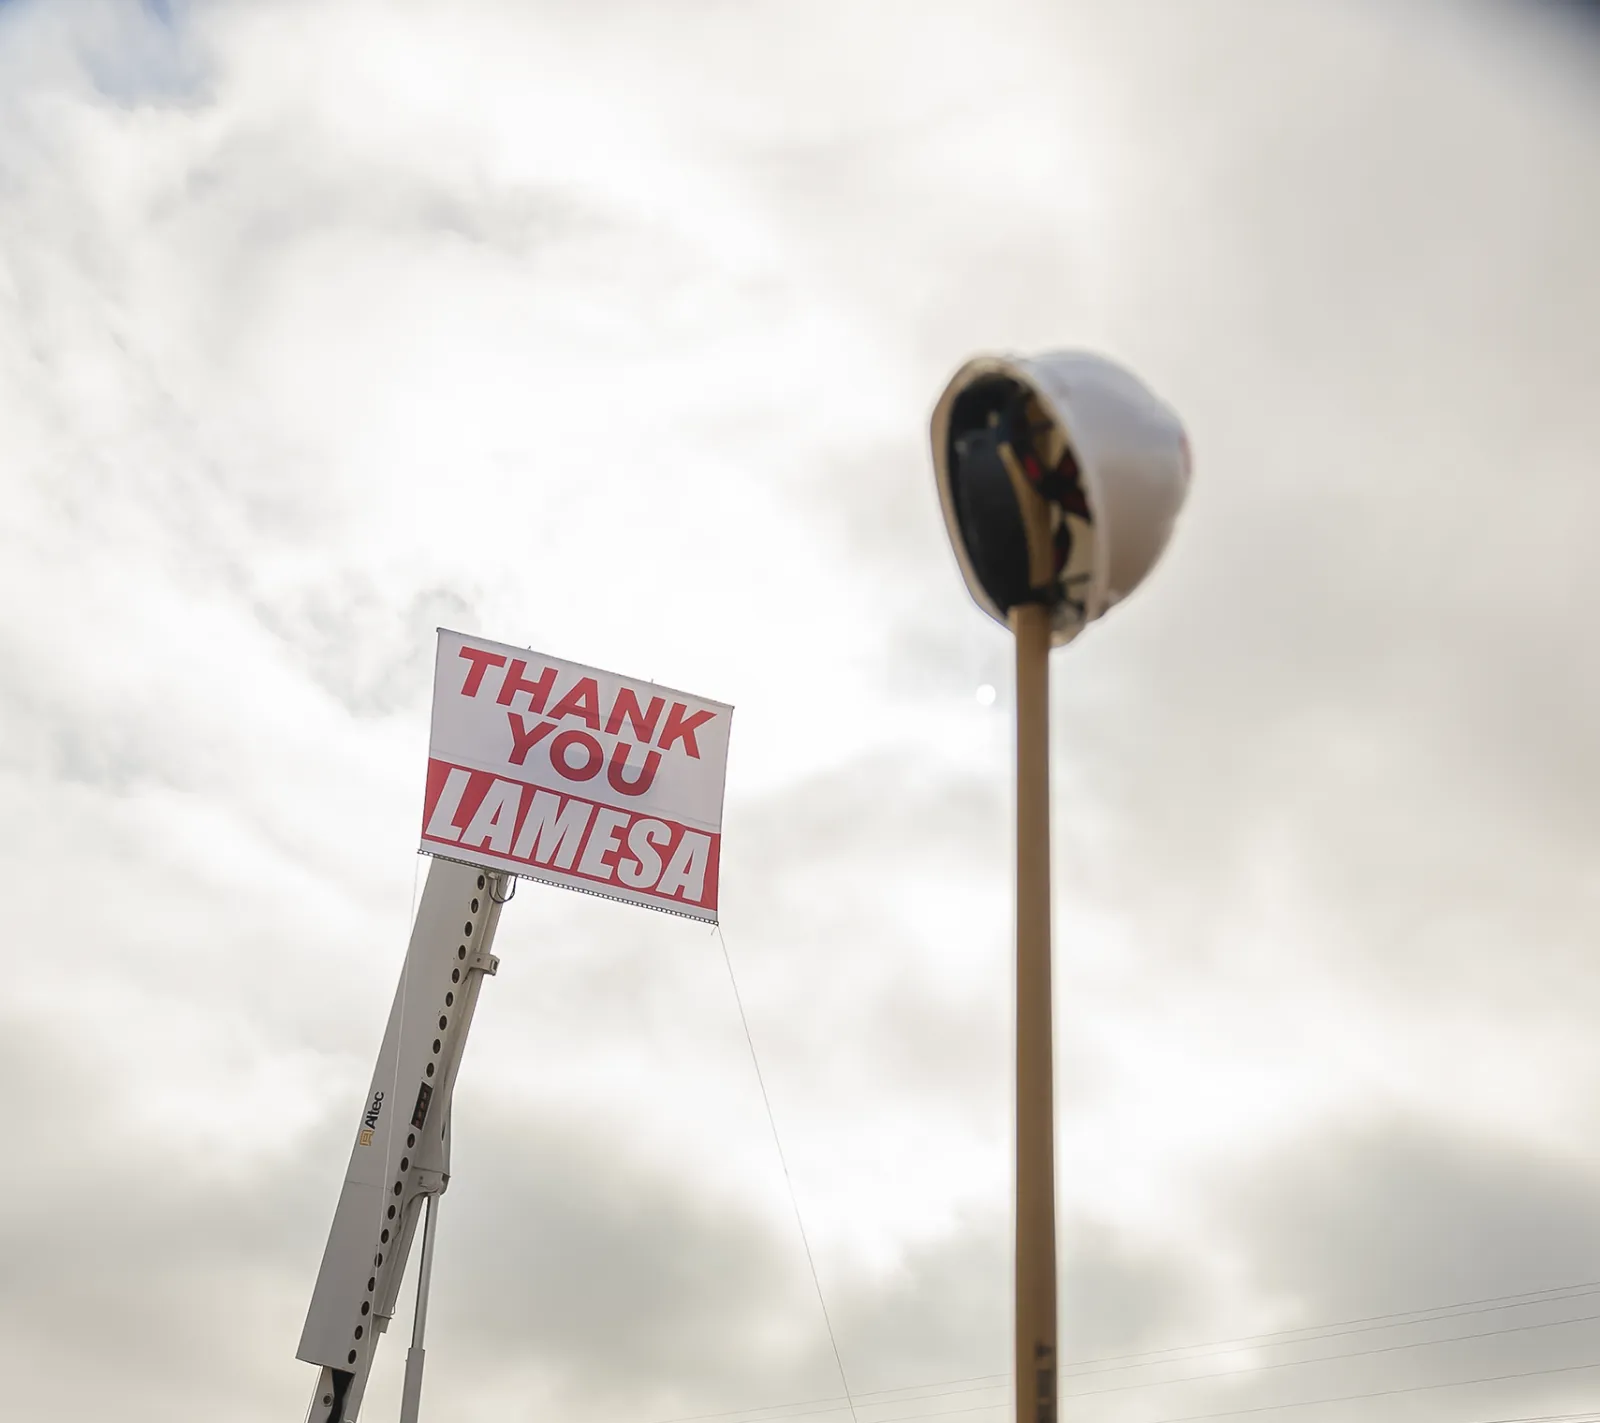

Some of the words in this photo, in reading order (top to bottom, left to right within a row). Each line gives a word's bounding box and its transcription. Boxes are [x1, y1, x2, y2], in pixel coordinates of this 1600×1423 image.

[459, 646, 717, 760] THANK
[507, 711, 662, 796] YOU
[425, 767, 711, 902] LAMESA
[365, 1091, 384, 1130] Altec
